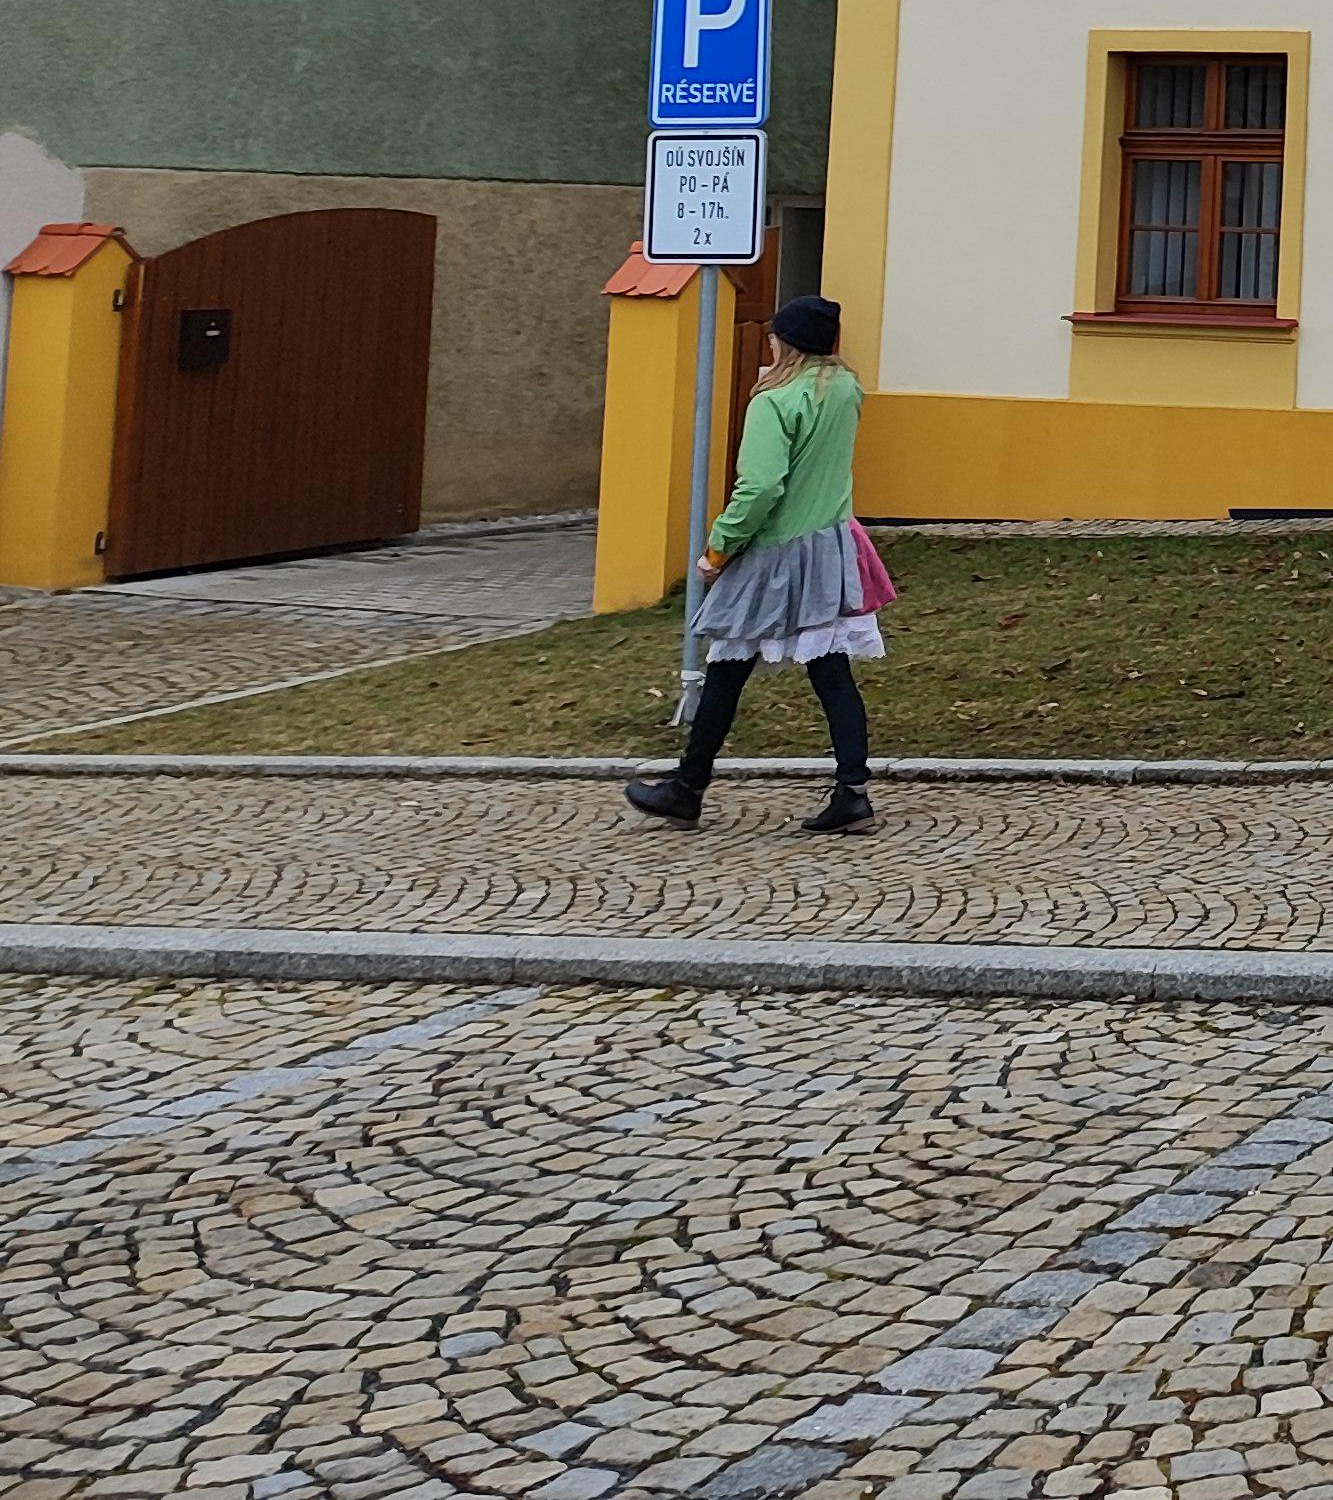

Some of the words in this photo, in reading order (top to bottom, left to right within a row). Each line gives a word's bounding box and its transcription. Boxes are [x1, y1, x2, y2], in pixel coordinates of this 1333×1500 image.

[660, 77, 755, 104] RÉSERVÉ
[666, 146, 684, 168] OÚ
[687, 145, 745, 168] SVOJŠÍN
[679, 175, 697, 193] PO
[712, 171, 730, 193] PÁ
[677, 202, 685, 219] 8
[701, 201, 729, 219] 17h.
[693, 227, 701, 245] 2
[703, 232, 712, 245] x
